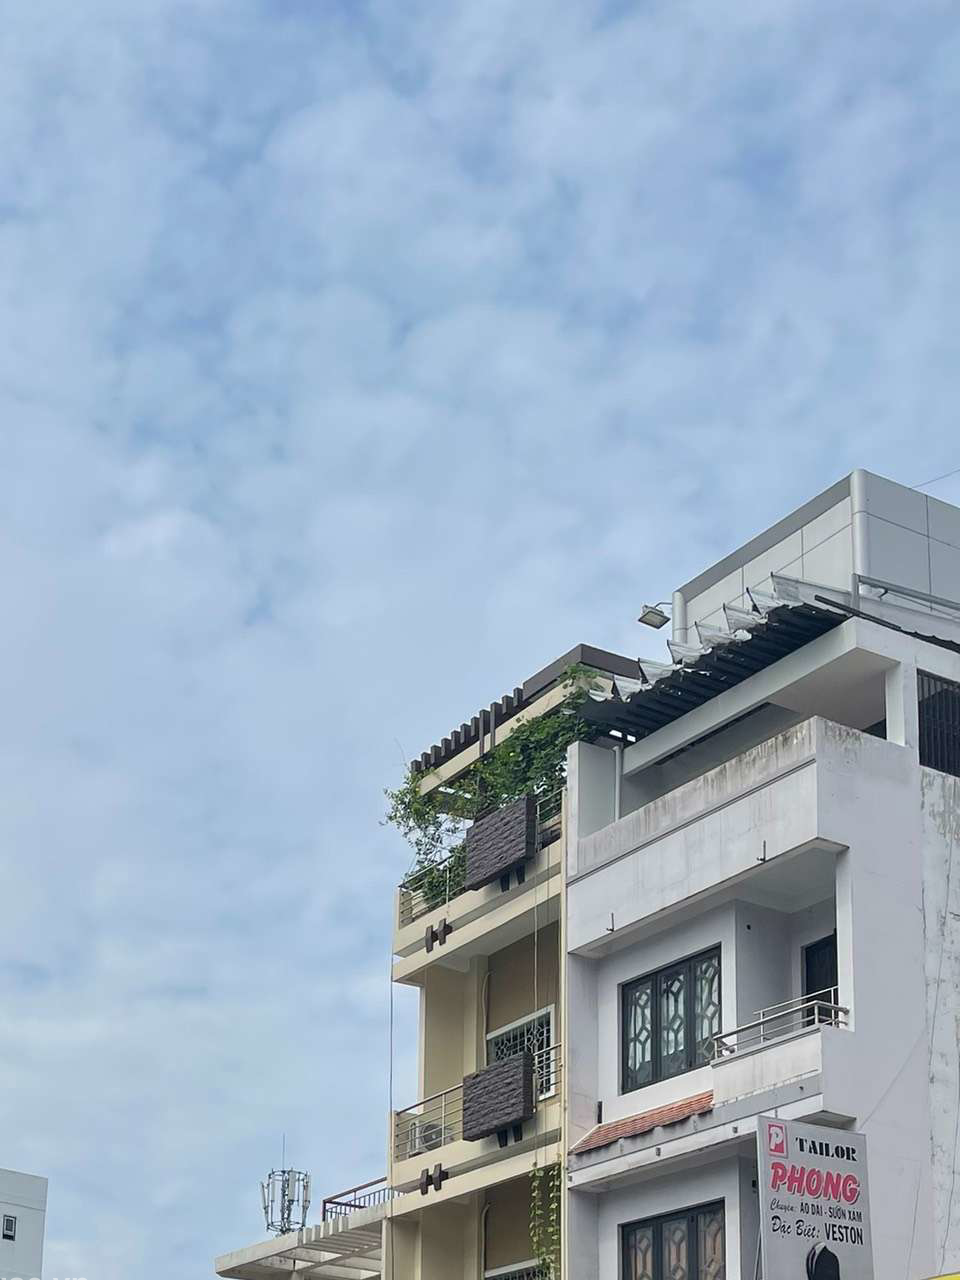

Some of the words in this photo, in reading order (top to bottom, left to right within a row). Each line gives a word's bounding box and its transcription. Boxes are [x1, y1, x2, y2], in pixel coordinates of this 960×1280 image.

[795, 1137, 857, 1162] TAILOR
[771, 1162, 860, 1205] PHONG
[771, 1215, 792, 1239] Đặc
[824, 1222, 863, 1245] VESTON
